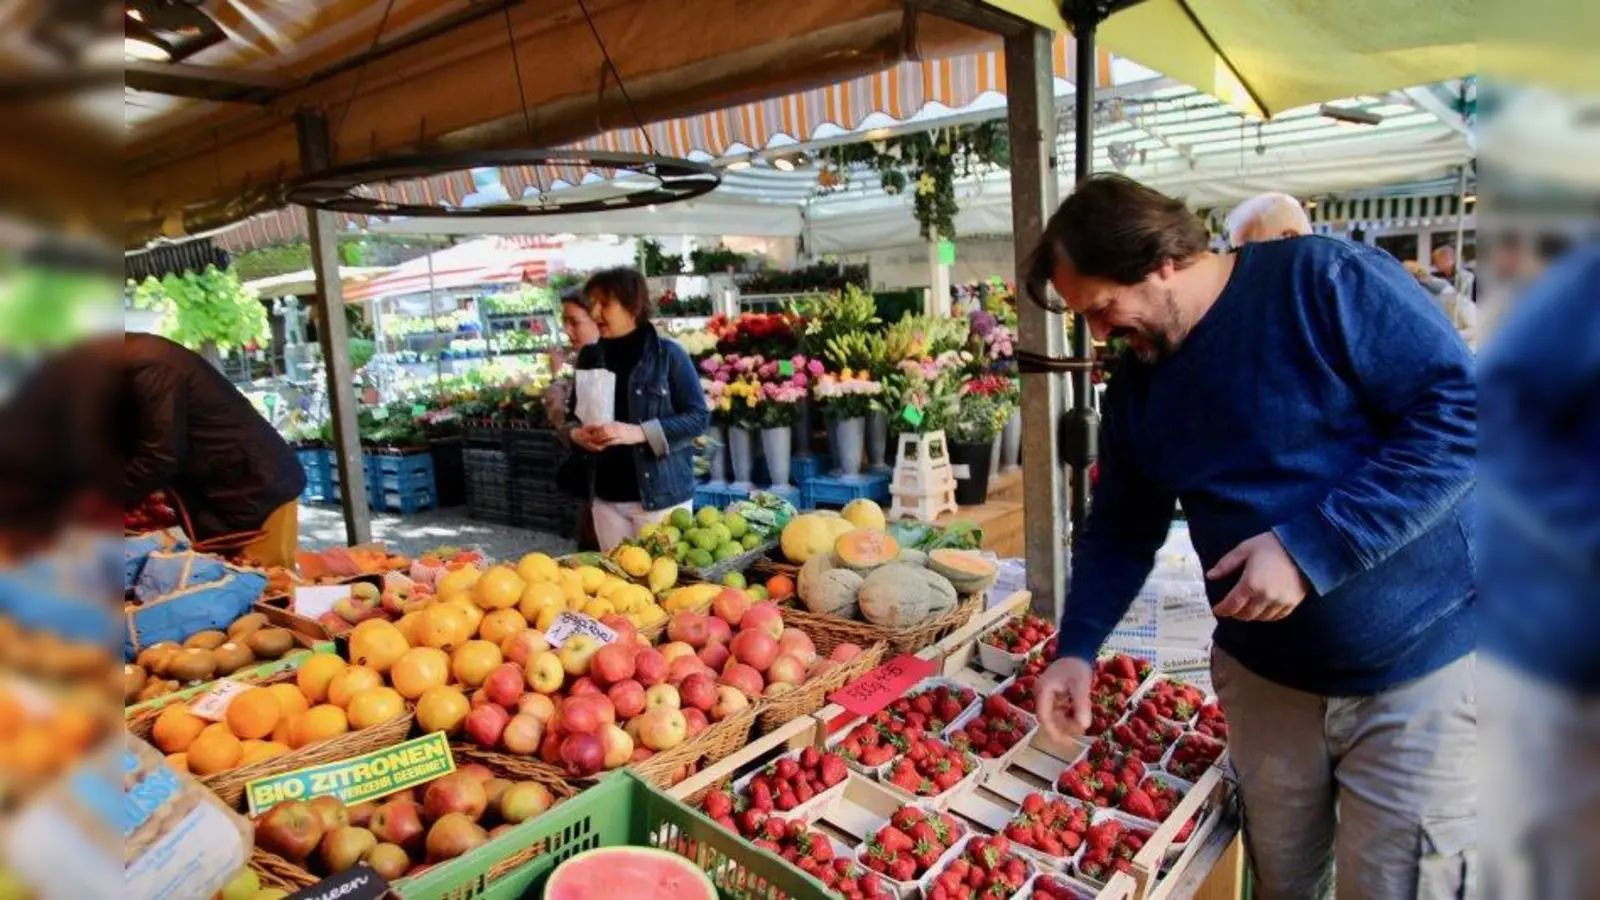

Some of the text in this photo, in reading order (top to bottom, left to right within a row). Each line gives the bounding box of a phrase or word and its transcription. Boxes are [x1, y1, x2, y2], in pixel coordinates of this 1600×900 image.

[254, 778, 305, 805] BIO
[309, 739, 445, 793] ZITRONEN
[393, 758, 448, 783] GEEIGNET
